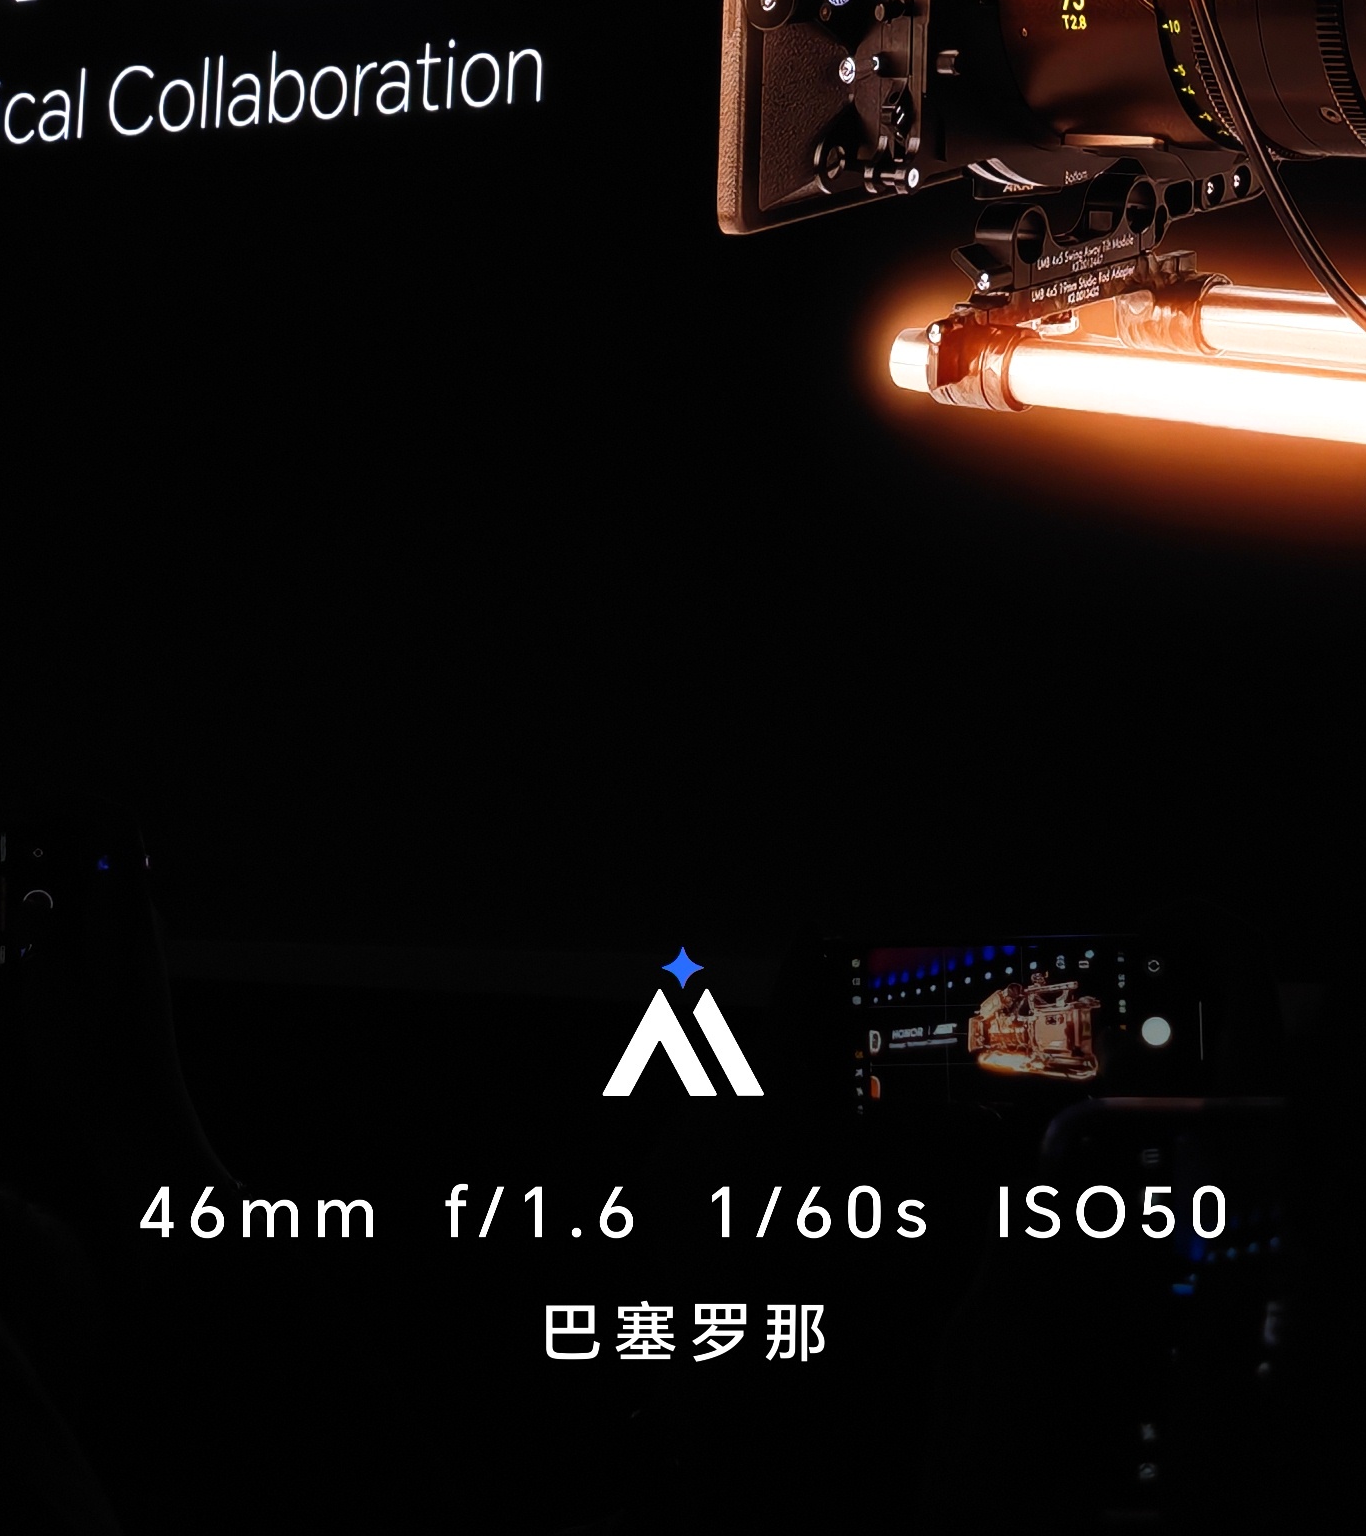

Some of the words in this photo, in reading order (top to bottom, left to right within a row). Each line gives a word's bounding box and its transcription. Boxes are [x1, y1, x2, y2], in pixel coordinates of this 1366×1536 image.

[1061, 14, 1087, 31] T2.8
[1168, 20, 1181, 33] 10
[108, 38, 543, 136] Collaboration
